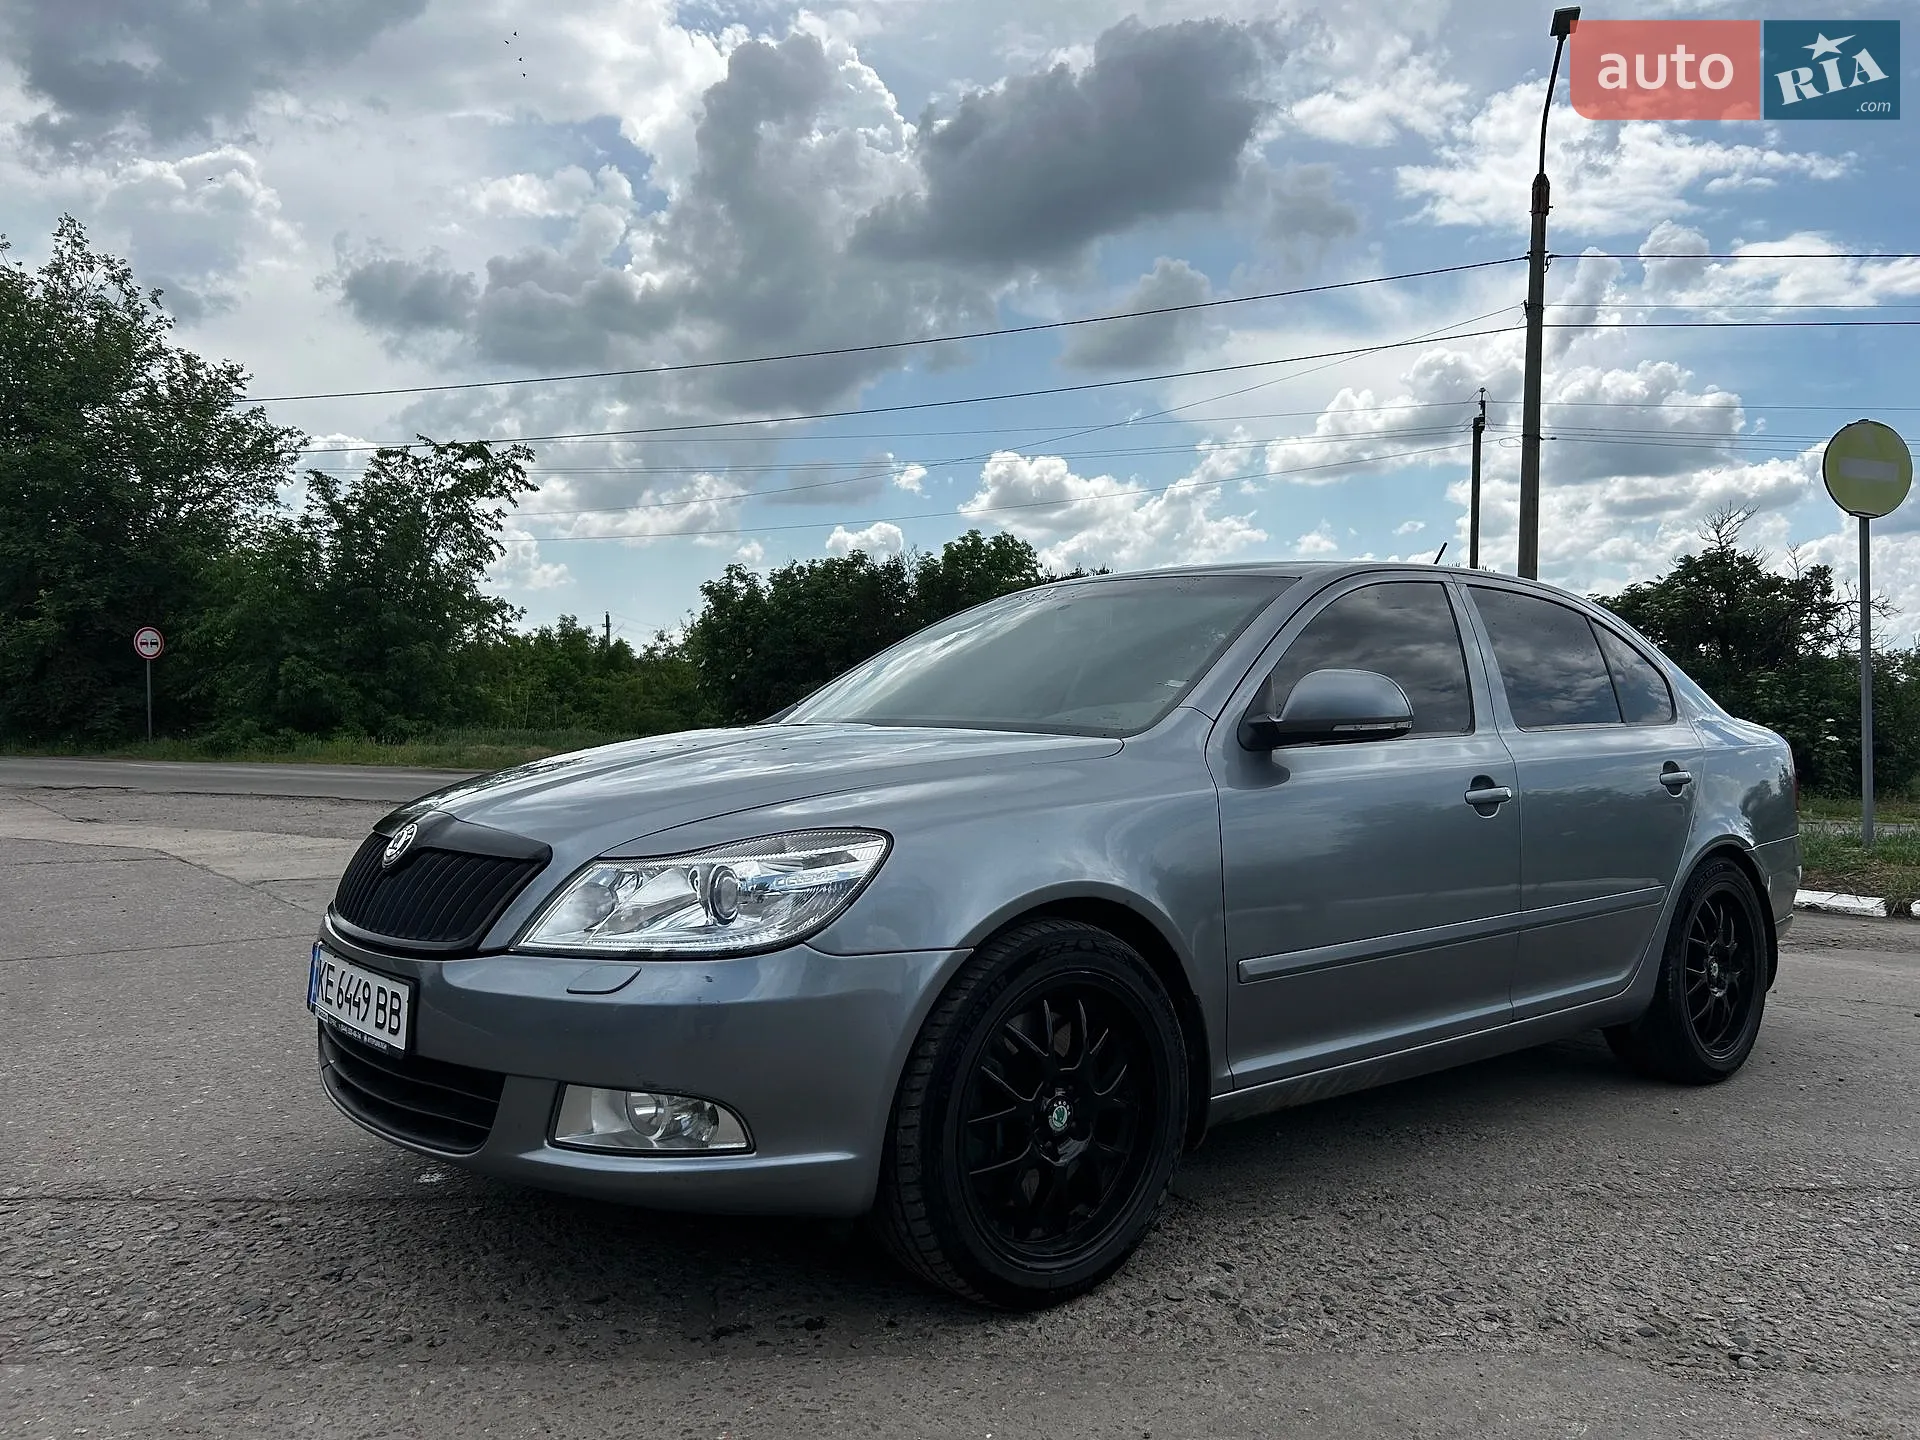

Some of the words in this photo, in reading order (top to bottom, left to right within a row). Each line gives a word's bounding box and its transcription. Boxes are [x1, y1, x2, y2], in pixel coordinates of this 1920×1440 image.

[316, 959, 335, 1006] KE
[336, 969, 371, 1022] 6449
[375, 985, 402, 1036] BB
